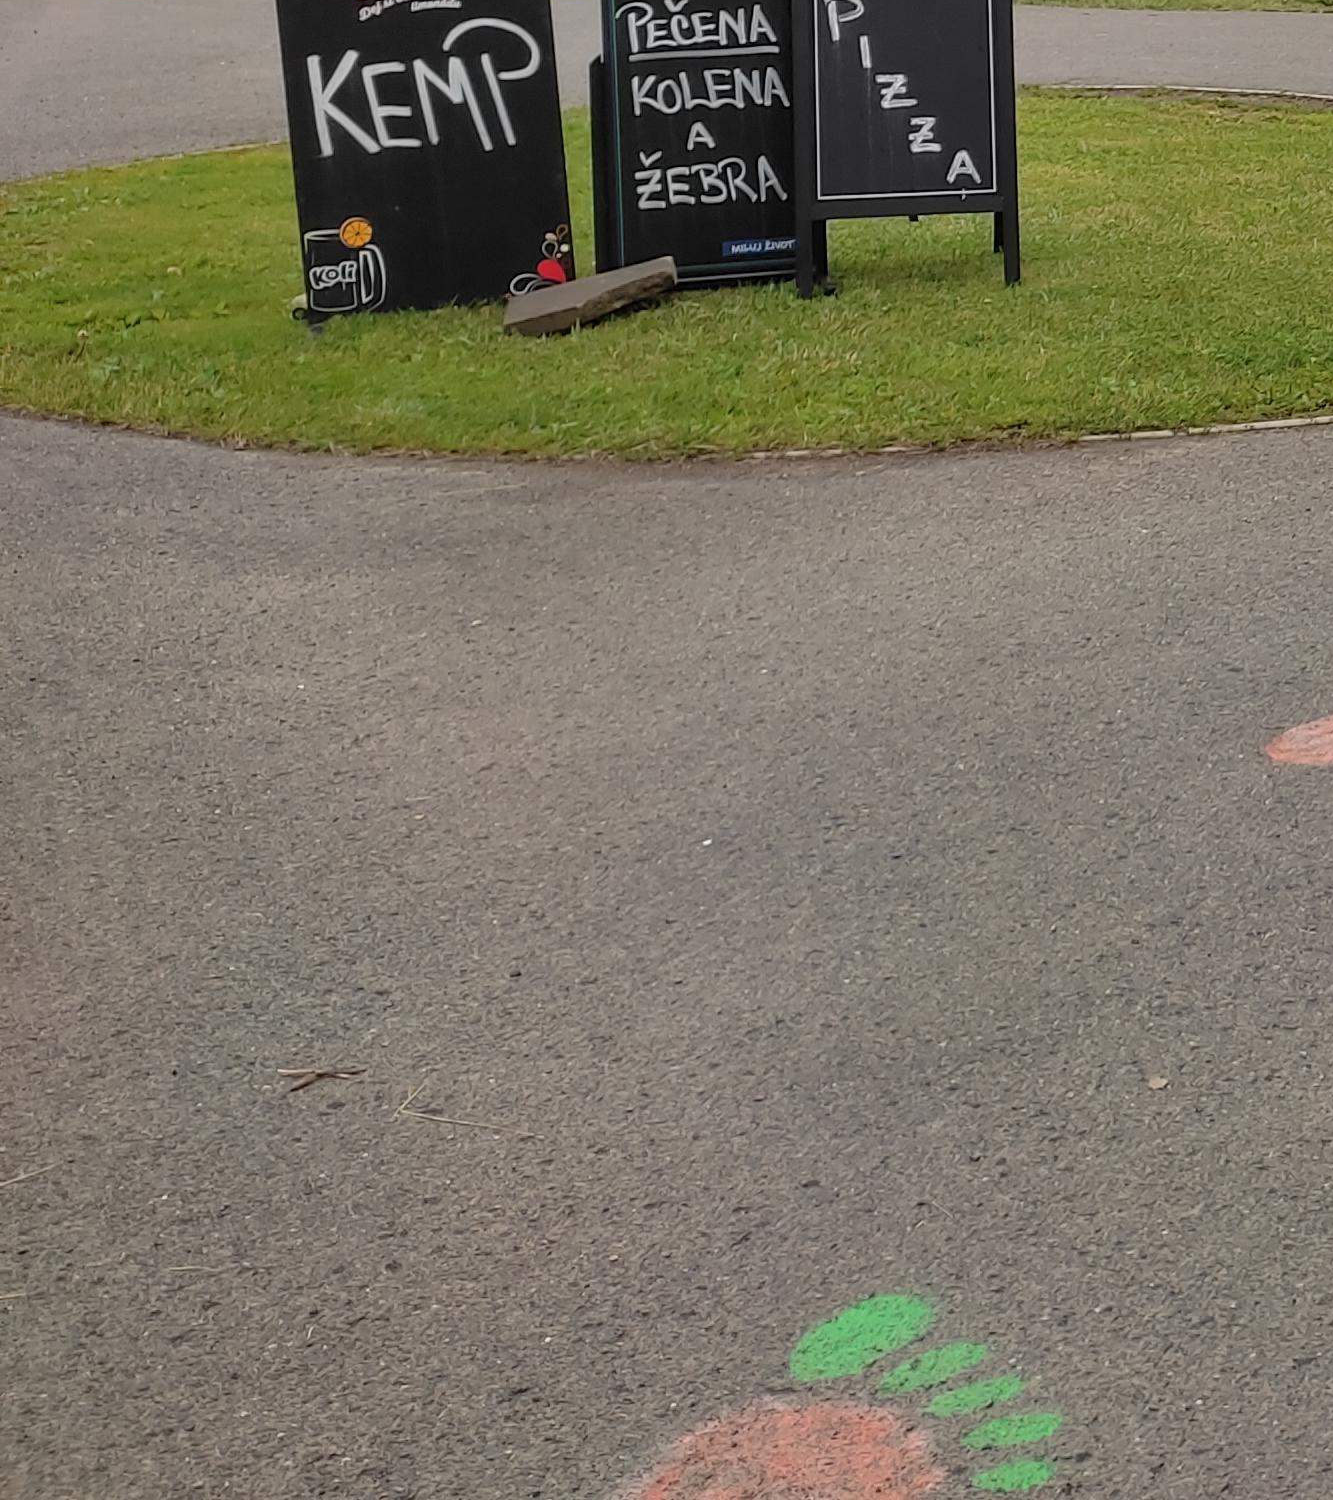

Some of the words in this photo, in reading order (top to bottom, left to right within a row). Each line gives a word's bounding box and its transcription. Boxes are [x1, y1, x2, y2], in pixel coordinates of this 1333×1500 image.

[307, 18, 541, 157] KEMP
[631, 66, 790, 116] KOLENA
[687, 121, 716, 150] A
[634, 150, 788, 210] ŽEBRA
